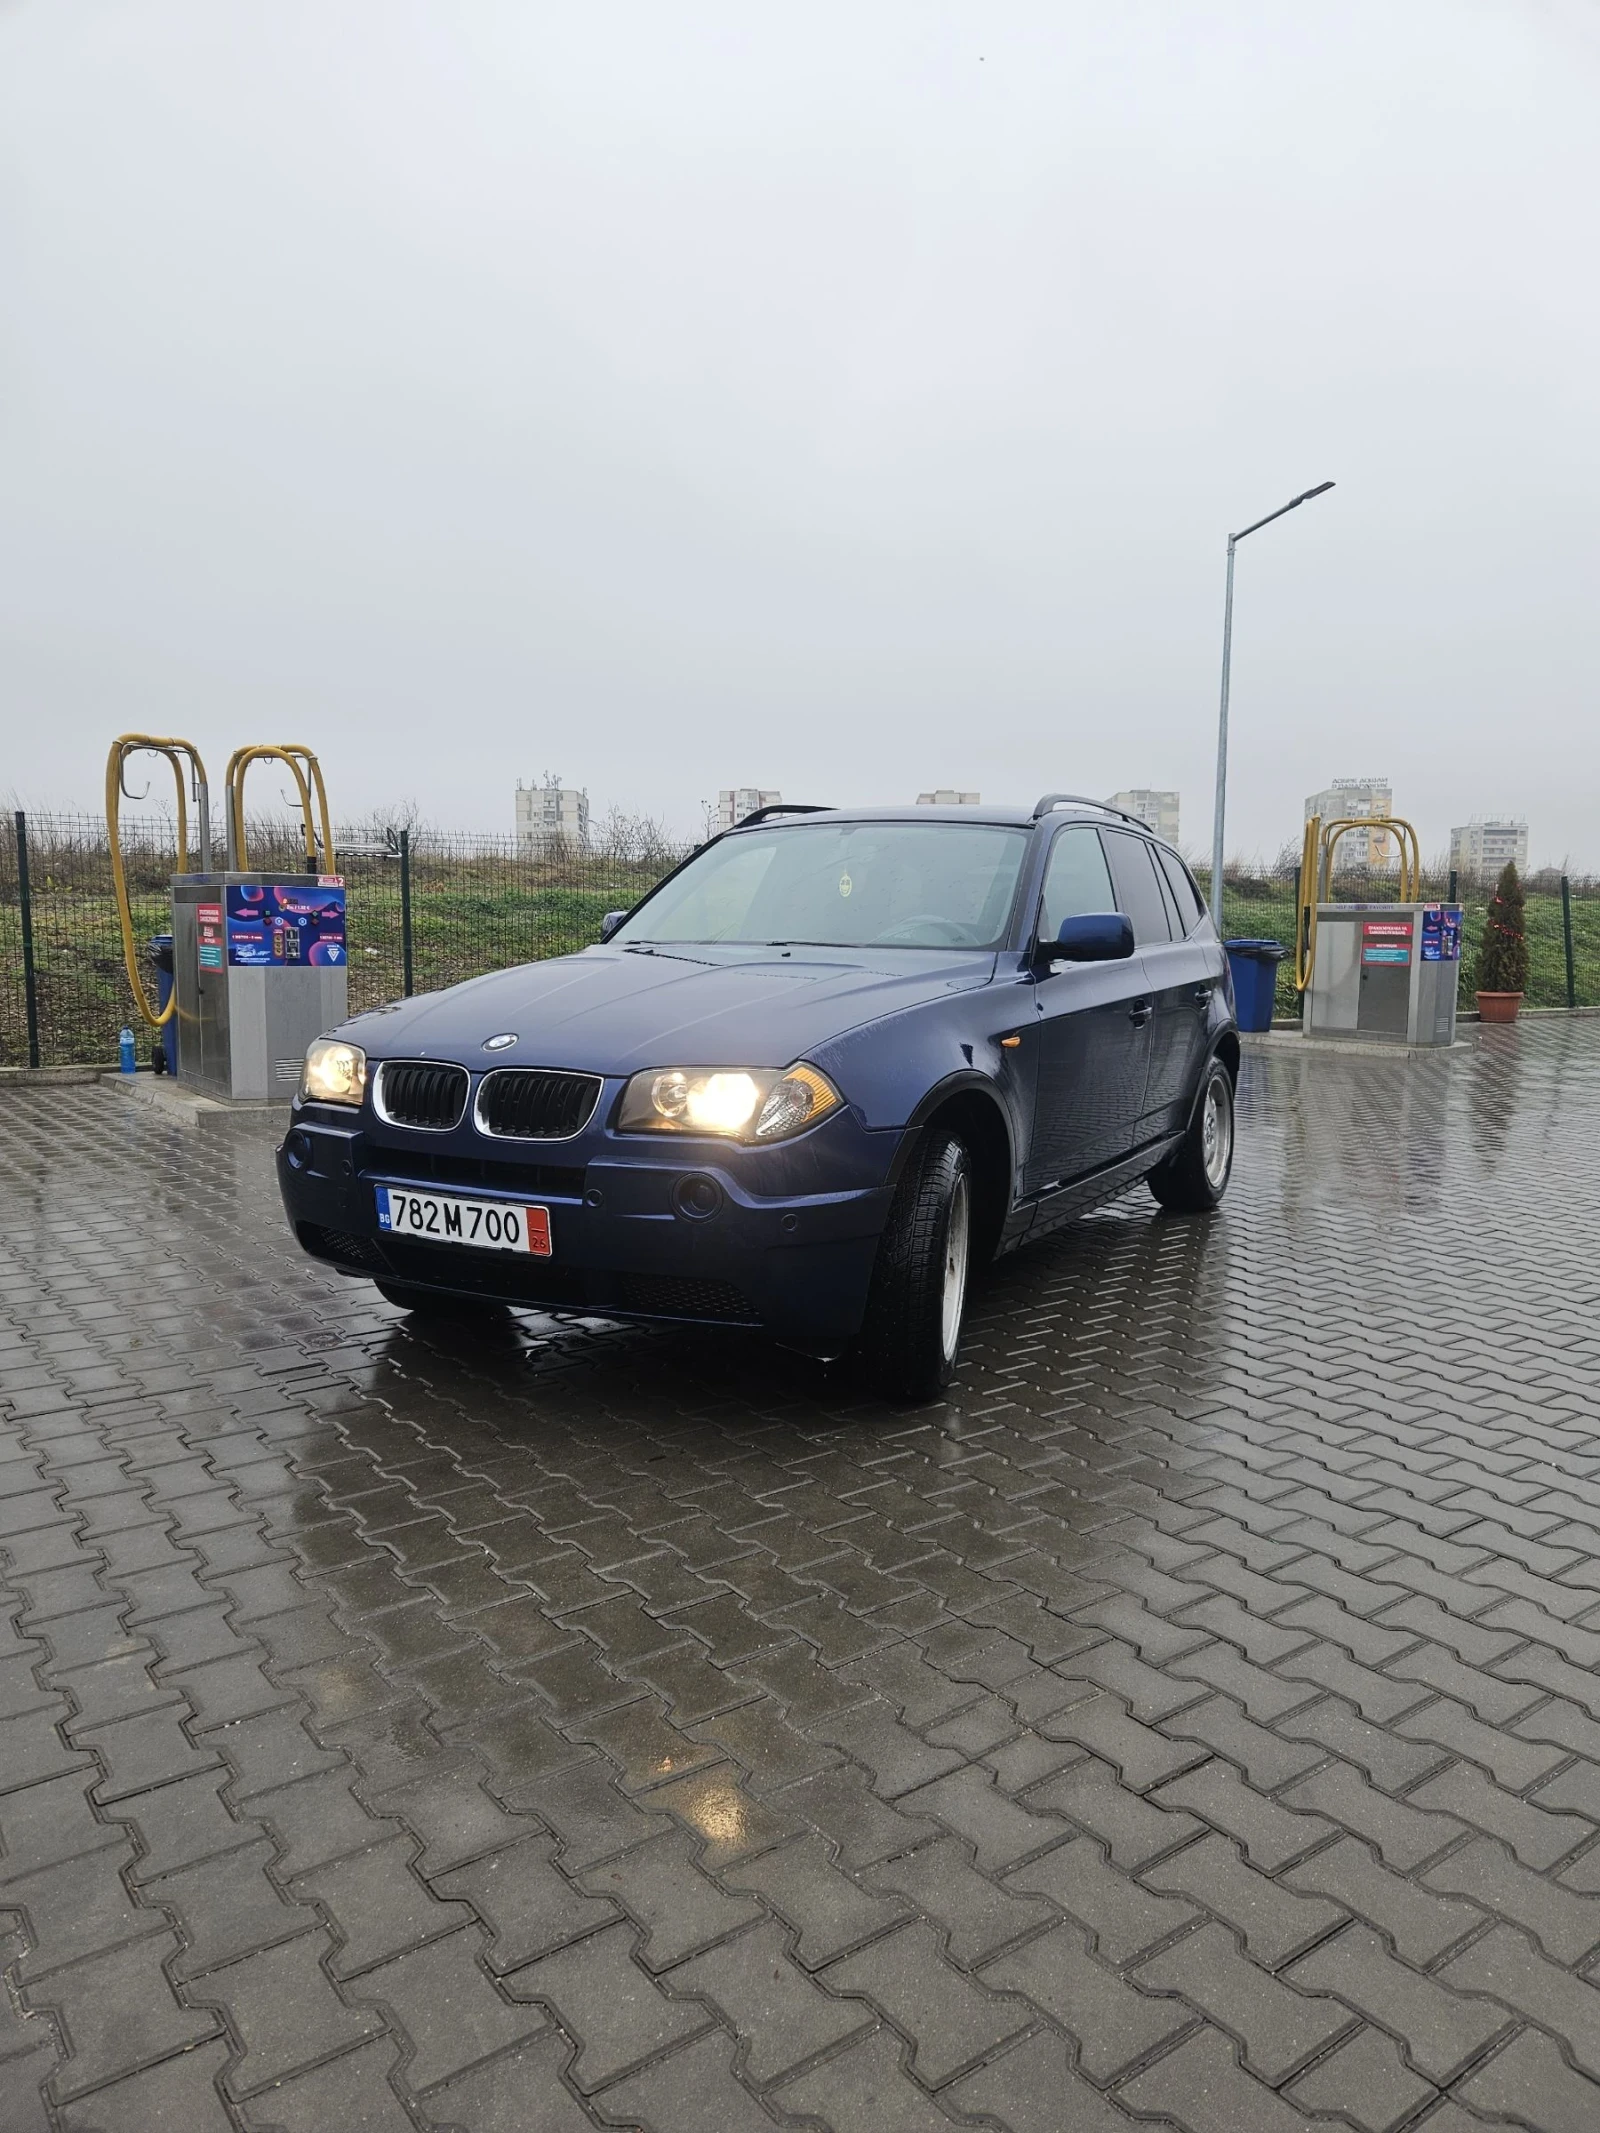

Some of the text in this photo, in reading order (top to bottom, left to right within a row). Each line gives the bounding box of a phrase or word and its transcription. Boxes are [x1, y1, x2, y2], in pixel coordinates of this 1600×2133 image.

[338, 877, 344, 887] 2
[379, 1213, 390, 1224] BG
[532, 1237, 546, 1249] 26
